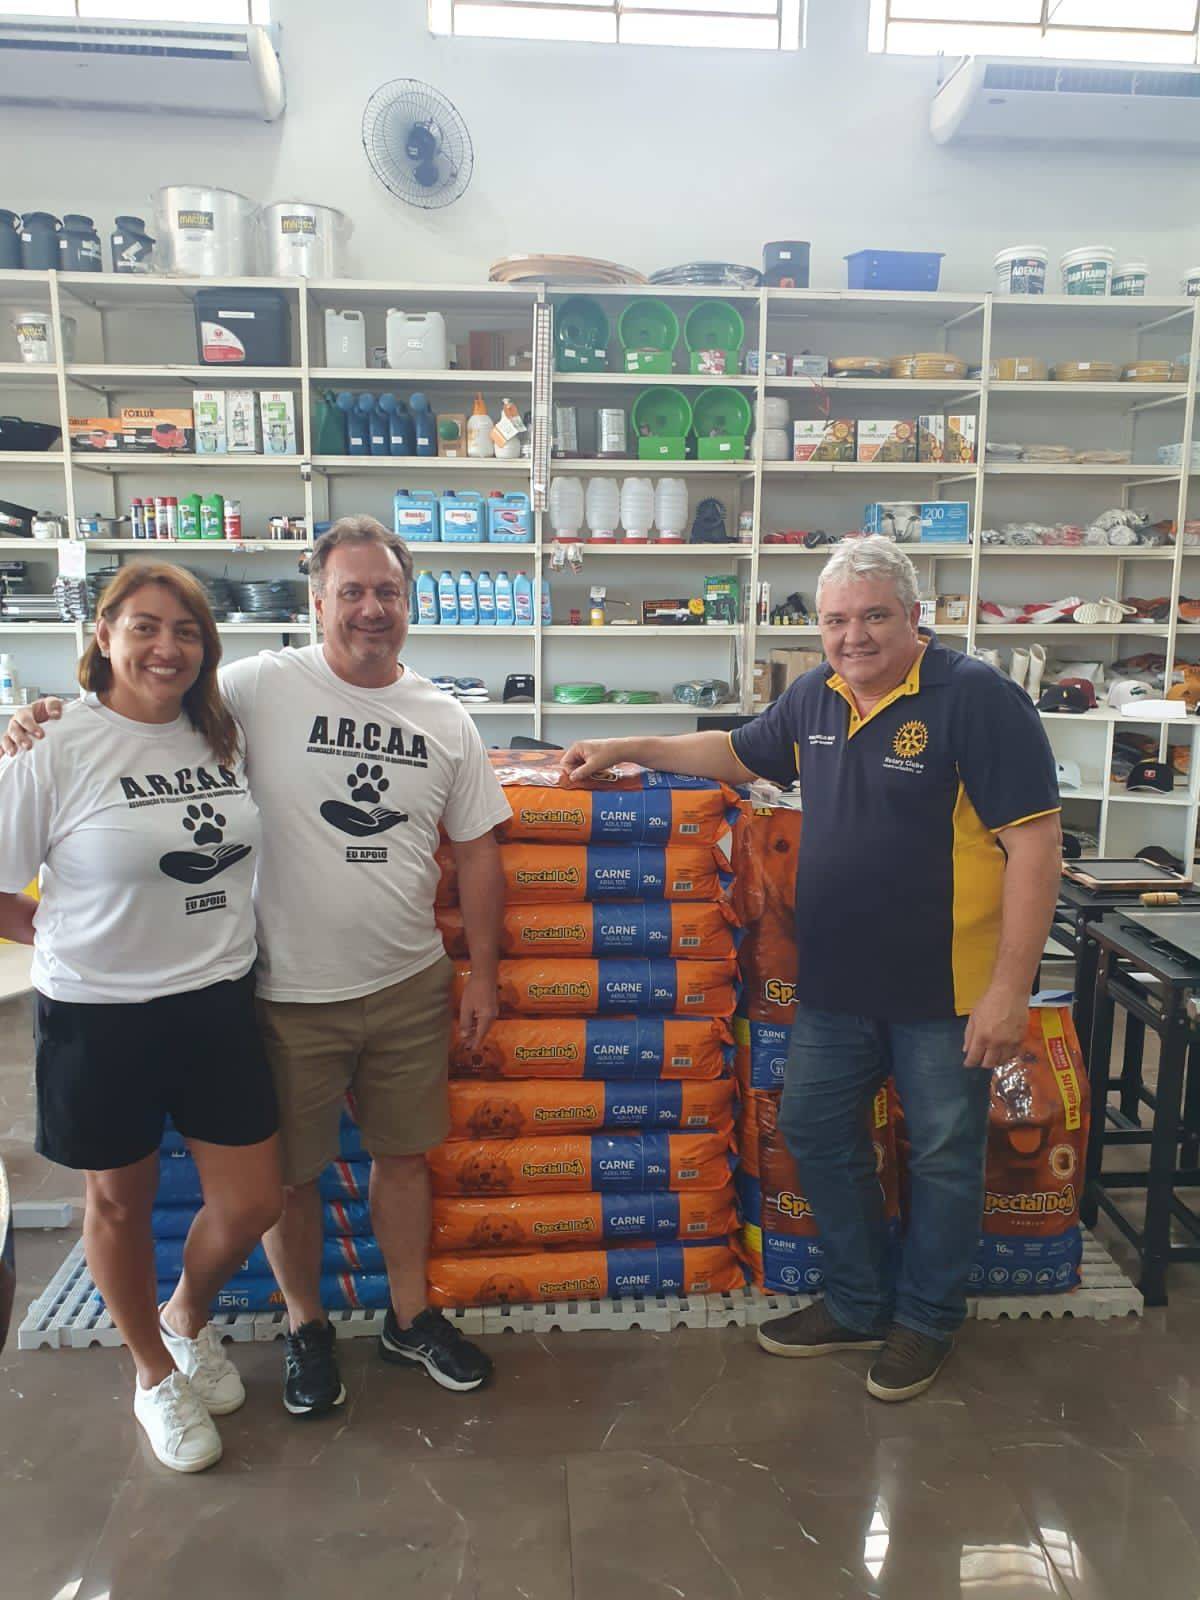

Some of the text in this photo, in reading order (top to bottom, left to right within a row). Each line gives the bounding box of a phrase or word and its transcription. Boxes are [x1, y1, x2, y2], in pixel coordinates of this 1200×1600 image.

[924, 507, 944, 520] 200
[308, 716, 429, 760] A.R.C.A.A
[521, 809, 584, 825] Special Dog
[600, 810, 636, 822] CARNE
[359, 850, 388, 859] APOIO
[516, 868, 579, 883] Special Dog
[595, 869, 631, 880] CARNE
[522, 925, 586, 941] Special Dog
[600, 925, 637, 936] CARNE
[528, 981, 592, 998] Special Dog
[606, 982, 643, 993] CARNE
[758, 1030, 786, 1040] CARNE
[515, 1044, 578, 1060] Special Dog
[593, 1045, 630, 1056] CARNE
[534, 1107, 574, 1121] Special
[612, 1105, 648, 1115] CARNE
[522, 1160, 585, 1176] Special Dog
[599, 1160, 635, 1170] CARNE
[984, 1193, 1045, 1212] pecial
[610, 1215, 646, 1226] CARNE
[534, 1221, 572, 1235] Special
[768, 1238, 797, 1249] CARNE
[540, 1279, 578, 1294] Special
[615, 1274, 651, 1286] CARNE
[218, 1295, 249, 1308] 15kg
